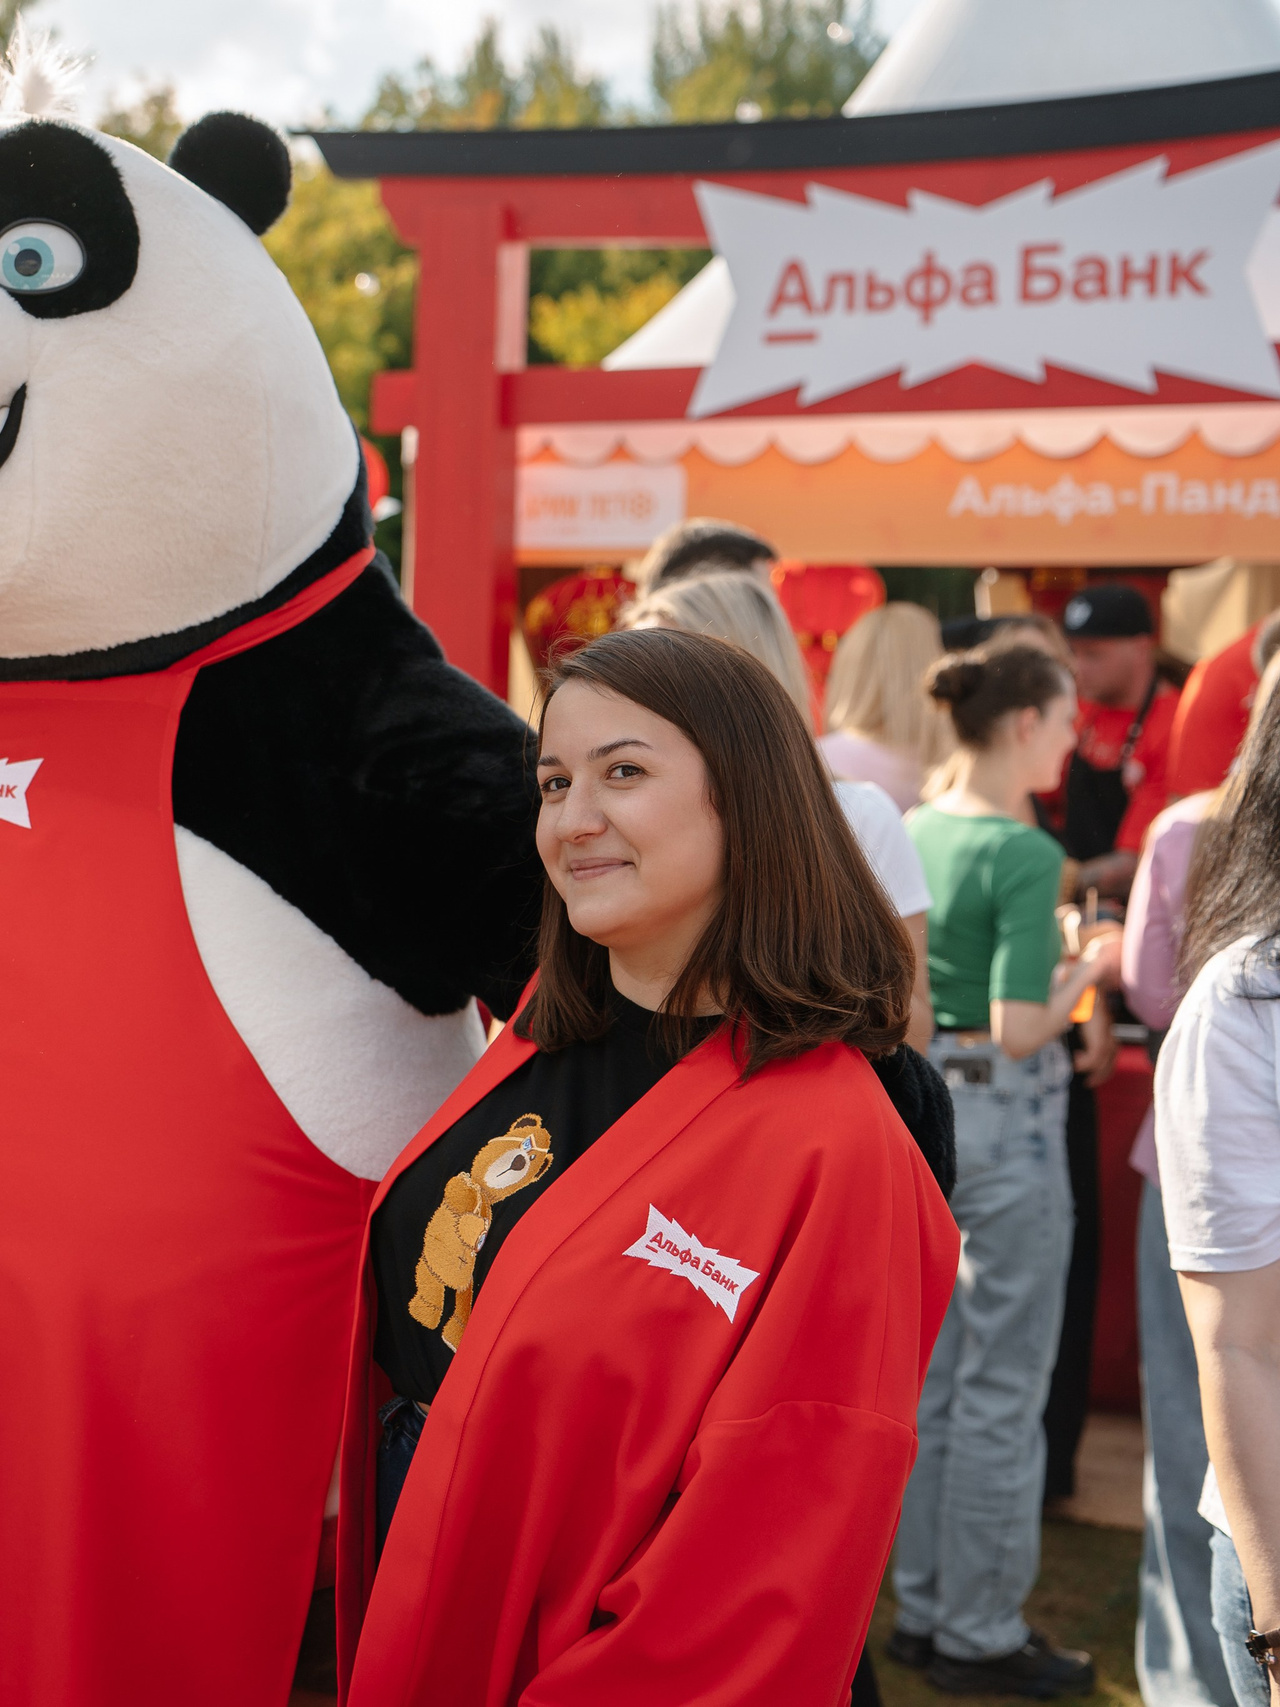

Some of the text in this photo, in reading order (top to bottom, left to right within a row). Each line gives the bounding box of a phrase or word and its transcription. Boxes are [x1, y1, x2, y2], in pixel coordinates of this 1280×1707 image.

[764, 242, 1212, 343] Альфа Банк
[645, 1231, 739, 1294] Альфа Банк
